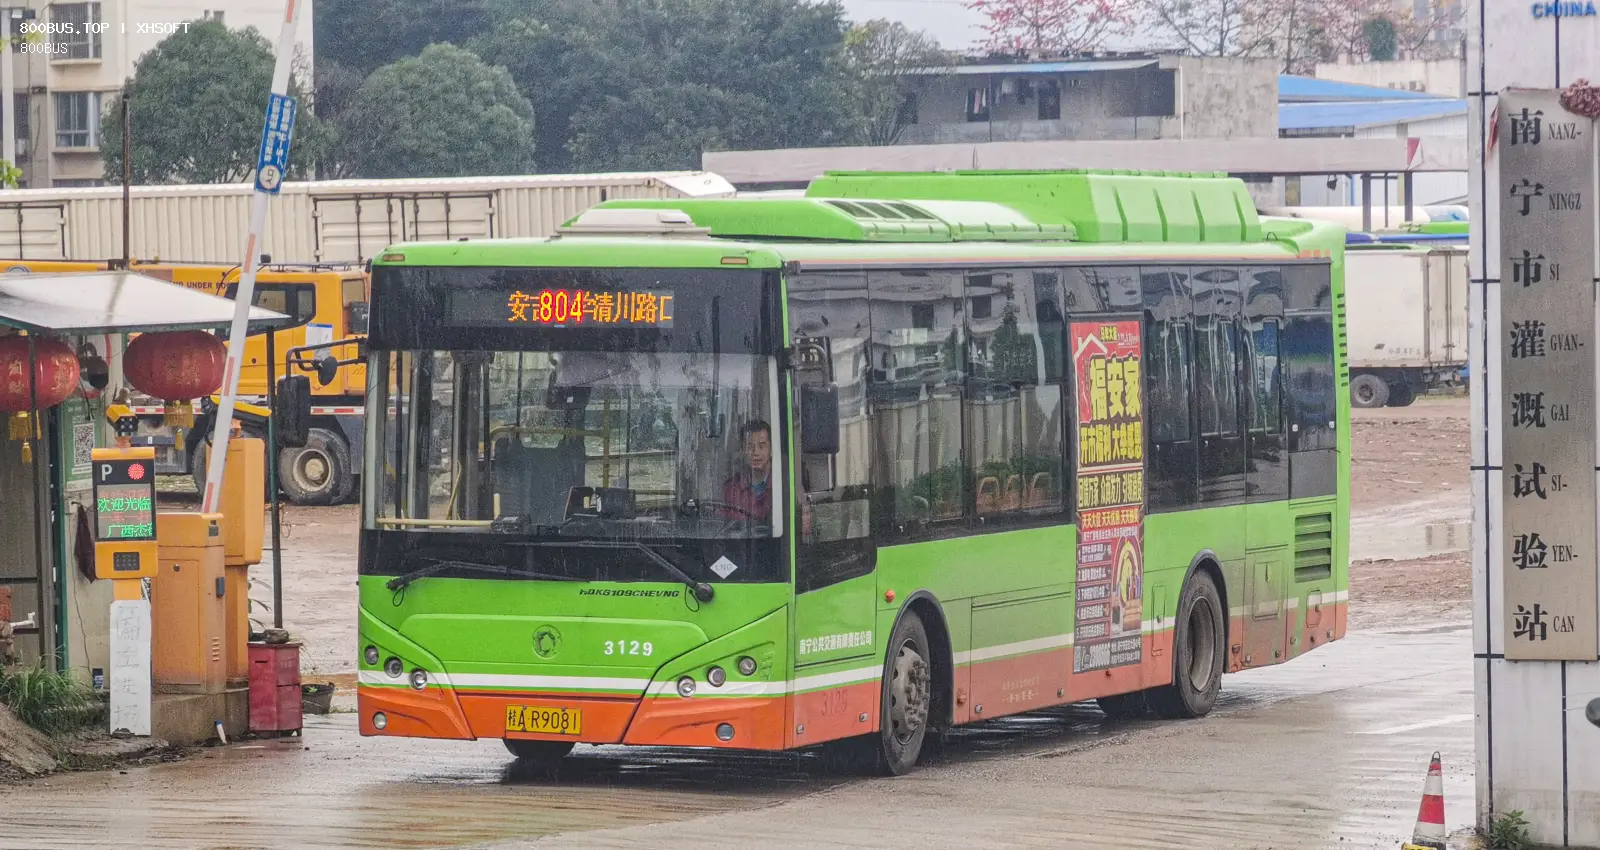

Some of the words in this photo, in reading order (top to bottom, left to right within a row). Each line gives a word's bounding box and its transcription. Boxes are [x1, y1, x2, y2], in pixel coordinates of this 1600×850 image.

[1531, 2, 1597, 17] CHINA
[1549, 193, 1582, 211] NINGZ
[1549, 264, 1560, 282] SI
[187, 281, 213, 289] UNDER
[539, 290, 584, 323] 804
[1090, 356, 1141, 421] 福安家
[1551, 404, 1570, 421] GAI
[101, 464, 113, 481] P
[97, 497, 152, 512] 欢迎光临
[714, 563, 733, 571] LNG
[1553, 616, 1575, 633] CAN
[604, 640, 653, 656] 3129
[799, 631, 872, 654] 南宁公共交通有限责任公司
